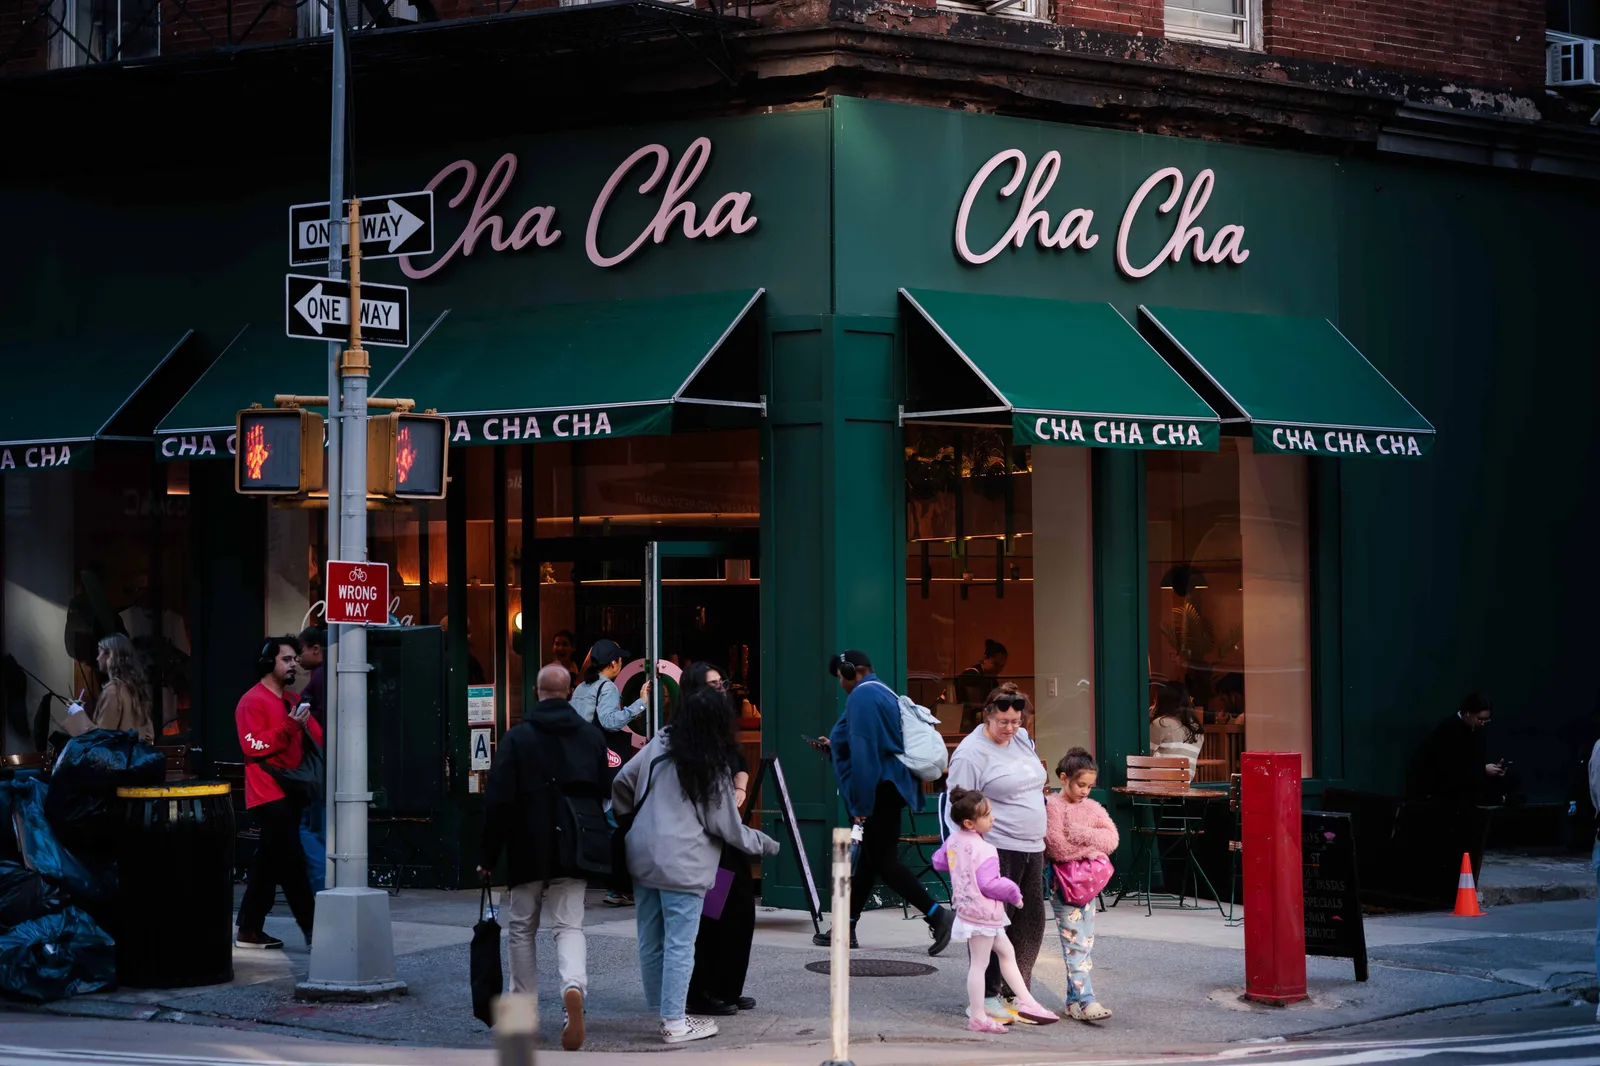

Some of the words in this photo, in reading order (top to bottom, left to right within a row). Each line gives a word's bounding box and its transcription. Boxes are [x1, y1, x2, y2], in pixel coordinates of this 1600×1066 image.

[399, 152, 563, 280] Cha
[585, 136, 758, 268] Cha
[955, 148, 1099, 265] Cha
[1116, 167, 1250, 279] Cha
[306, 222, 330, 246] ON
[362, 214, 403, 240] WAY
[307, 296, 341, 322] ONE
[360, 302, 392, 326] WAY
[483, 416, 542, 441] CHA
[552, 411, 612, 438] CHA
[1034, 417, 1085, 443] CHA
[1093, 420, 1144, 445] CHA
[1152, 423, 1204, 447] CHA
[25, 445, 71, 468] CHA
[161, 434, 216, 457] CHA
[1272, 428, 1319, 451] CHA
[1324, 431, 1372, 454] CHA
[1376, 433, 1423, 457] CHA
[338, 584, 377, 601] WRONG
[345, 602, 369, 617] WAY
[475, 734, 488, 759] A
[1303, 896, 1343, 909] SPECIALS
